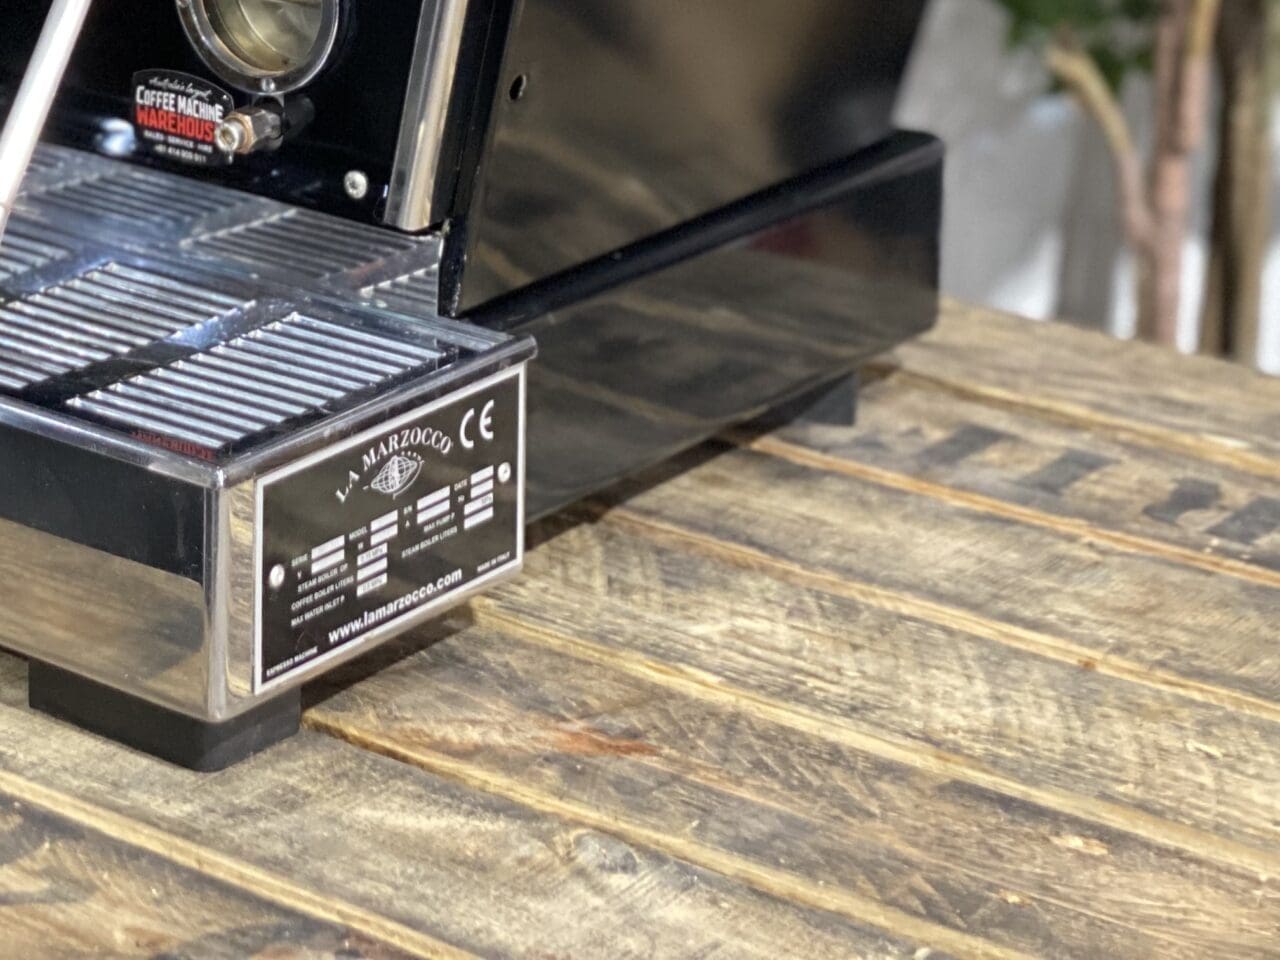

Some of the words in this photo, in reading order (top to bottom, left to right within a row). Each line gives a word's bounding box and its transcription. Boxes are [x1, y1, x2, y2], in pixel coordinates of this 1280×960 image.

[136, 85, 176, 112] COFFEE
[177, 94, 224, 123] MACHINE
[335, 470, 360, 504] LA
[361, 426, 452, 472] MARZOCCO
[291, 593, 313, 611] COFFEE
[314, 584, 334, 600] BOILER
[328, 568, 463, 644] www.lamarzocco.com
